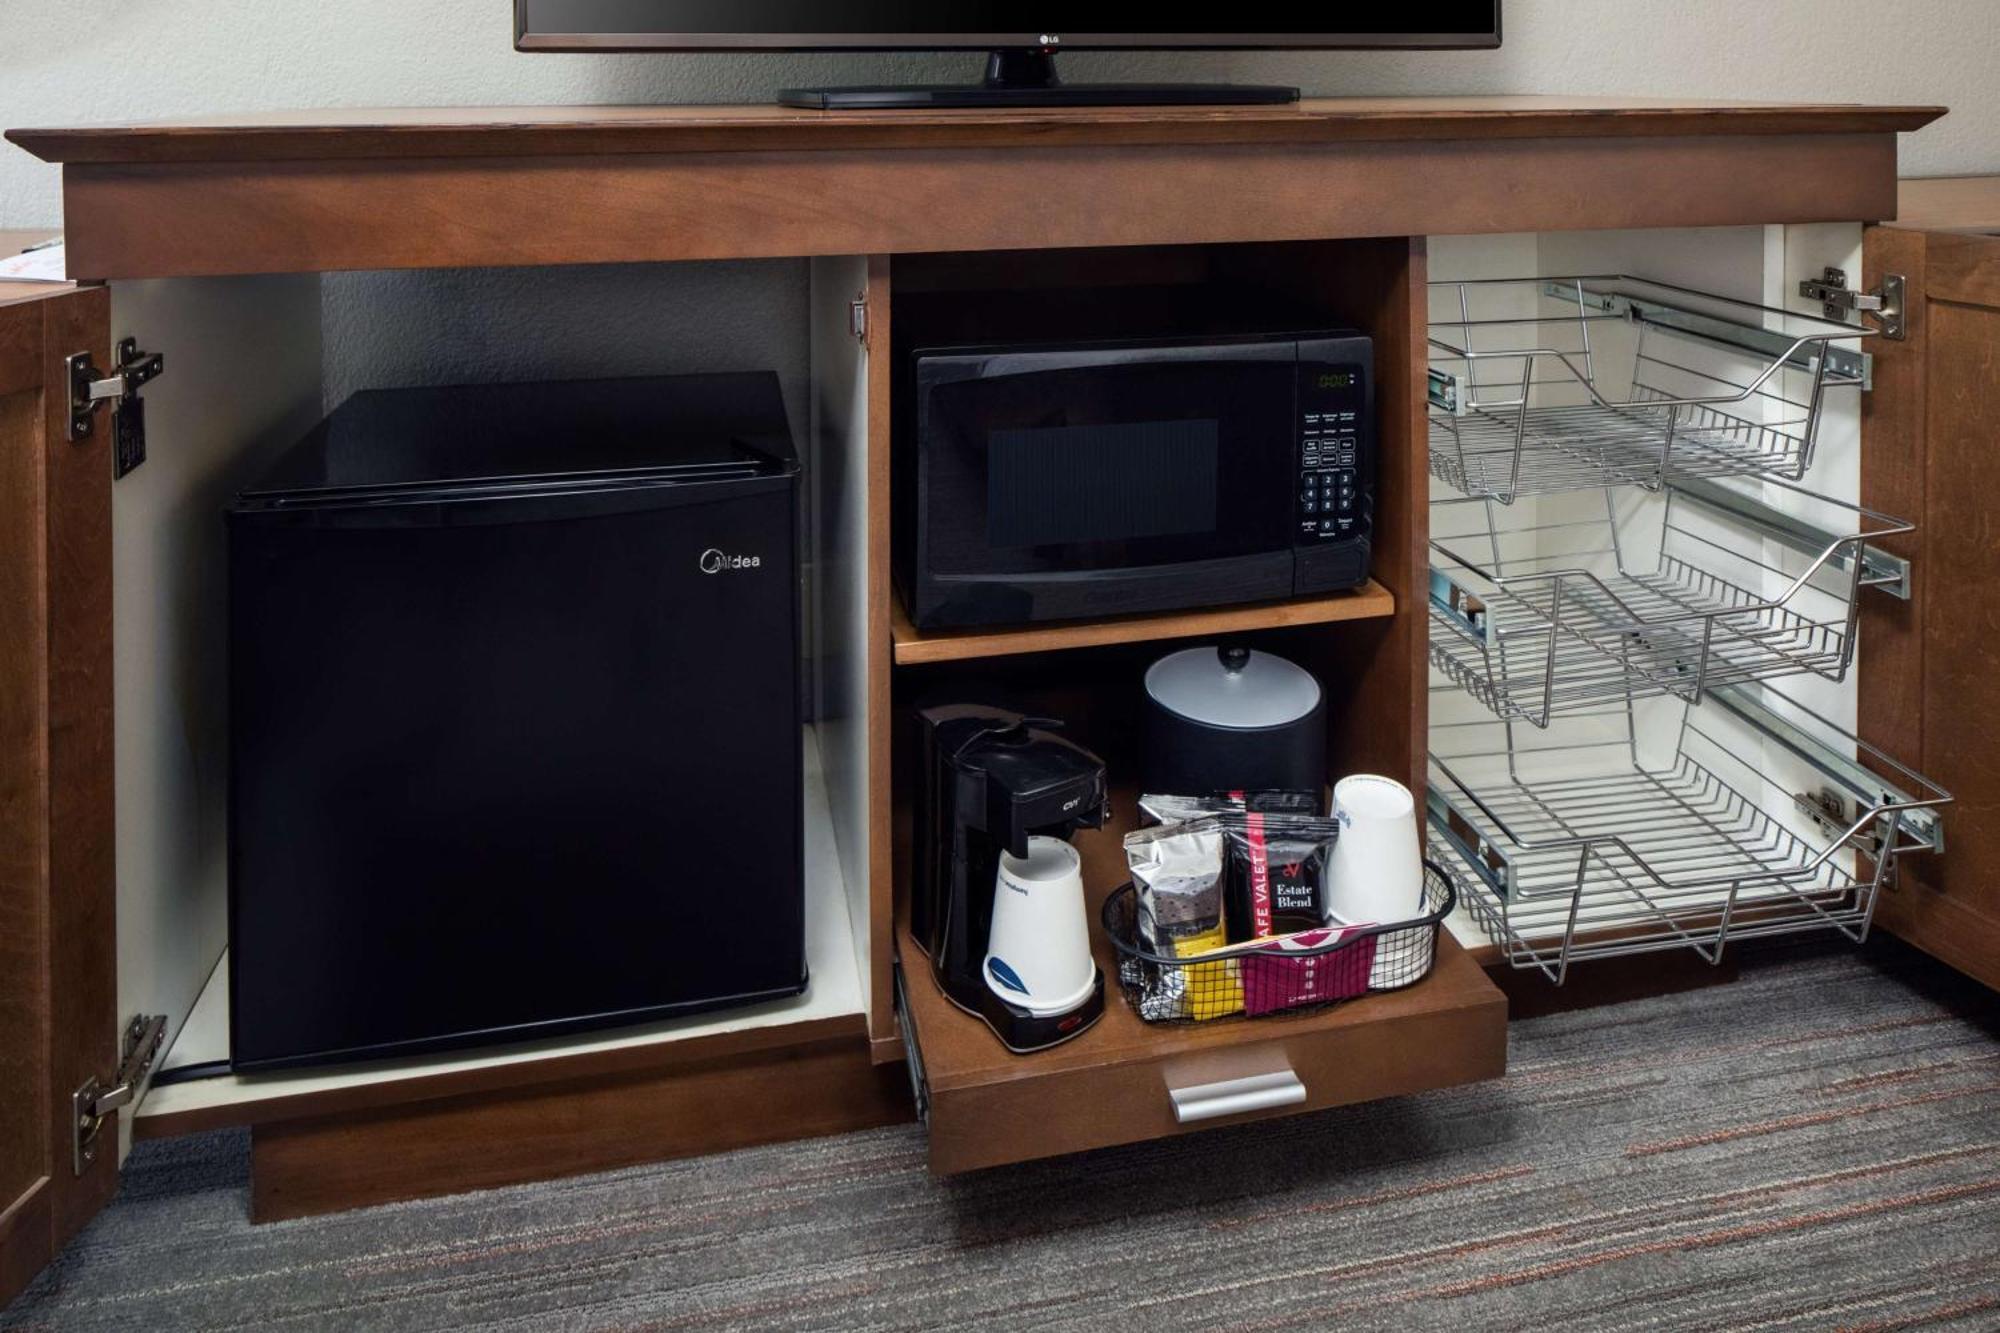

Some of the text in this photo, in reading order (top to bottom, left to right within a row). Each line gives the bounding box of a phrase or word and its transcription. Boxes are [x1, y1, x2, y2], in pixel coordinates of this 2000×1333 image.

[700, 548, 761, 574] Midea
[1252, 852, 1270, 937] AFE VALET
[1276, 884, 1313, 895] Estate
[1277, 895, 1312, 908] Blend
